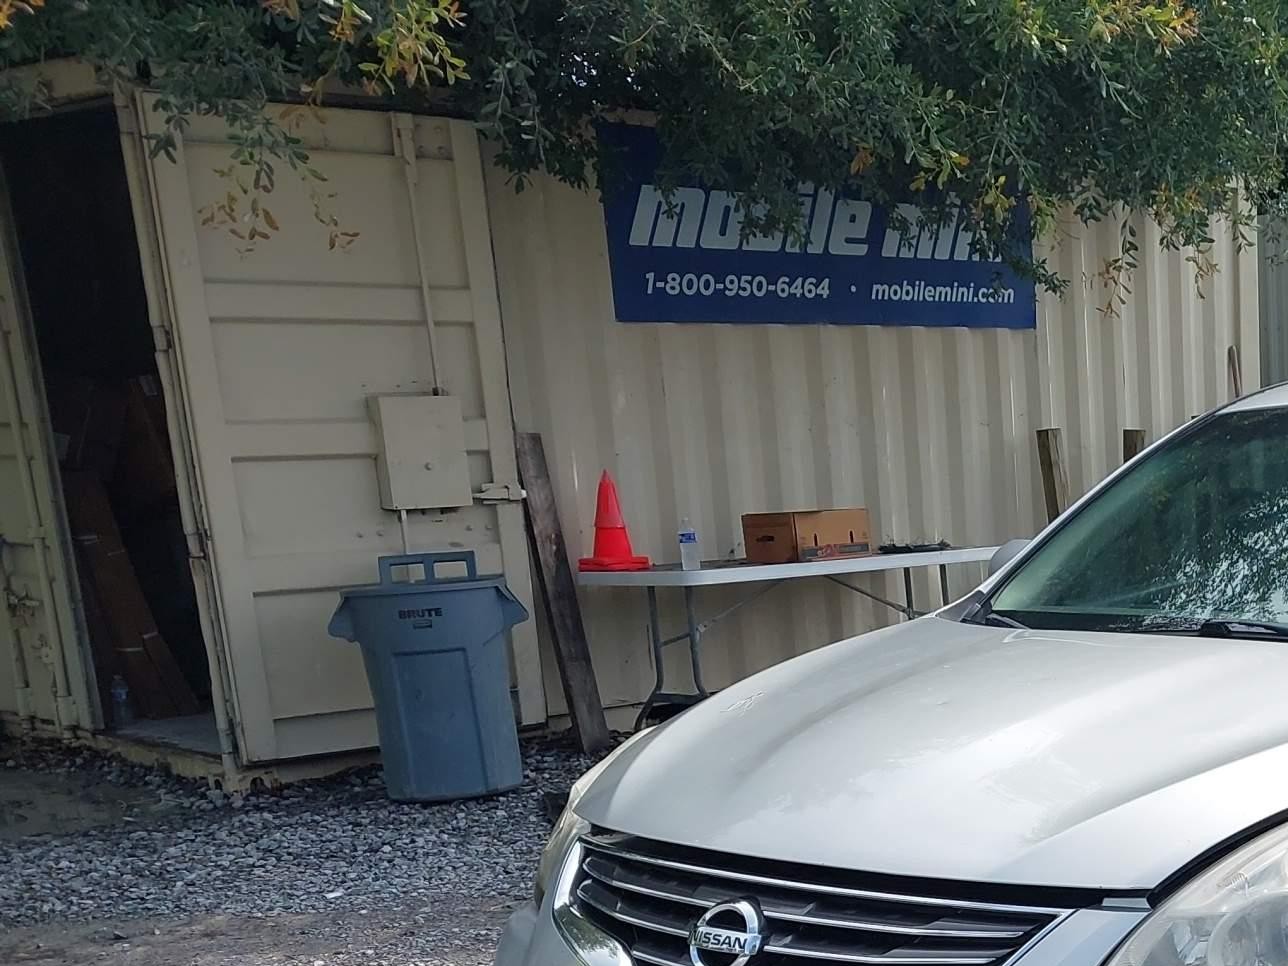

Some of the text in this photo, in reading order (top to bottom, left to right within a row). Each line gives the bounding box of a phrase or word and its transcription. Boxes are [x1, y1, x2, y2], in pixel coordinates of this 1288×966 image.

[645, 272, 831, 298] 1-800-950-6464
[398, 607, 443, 620] BRUTE
[689, 929, 748, 949] NISSAN
